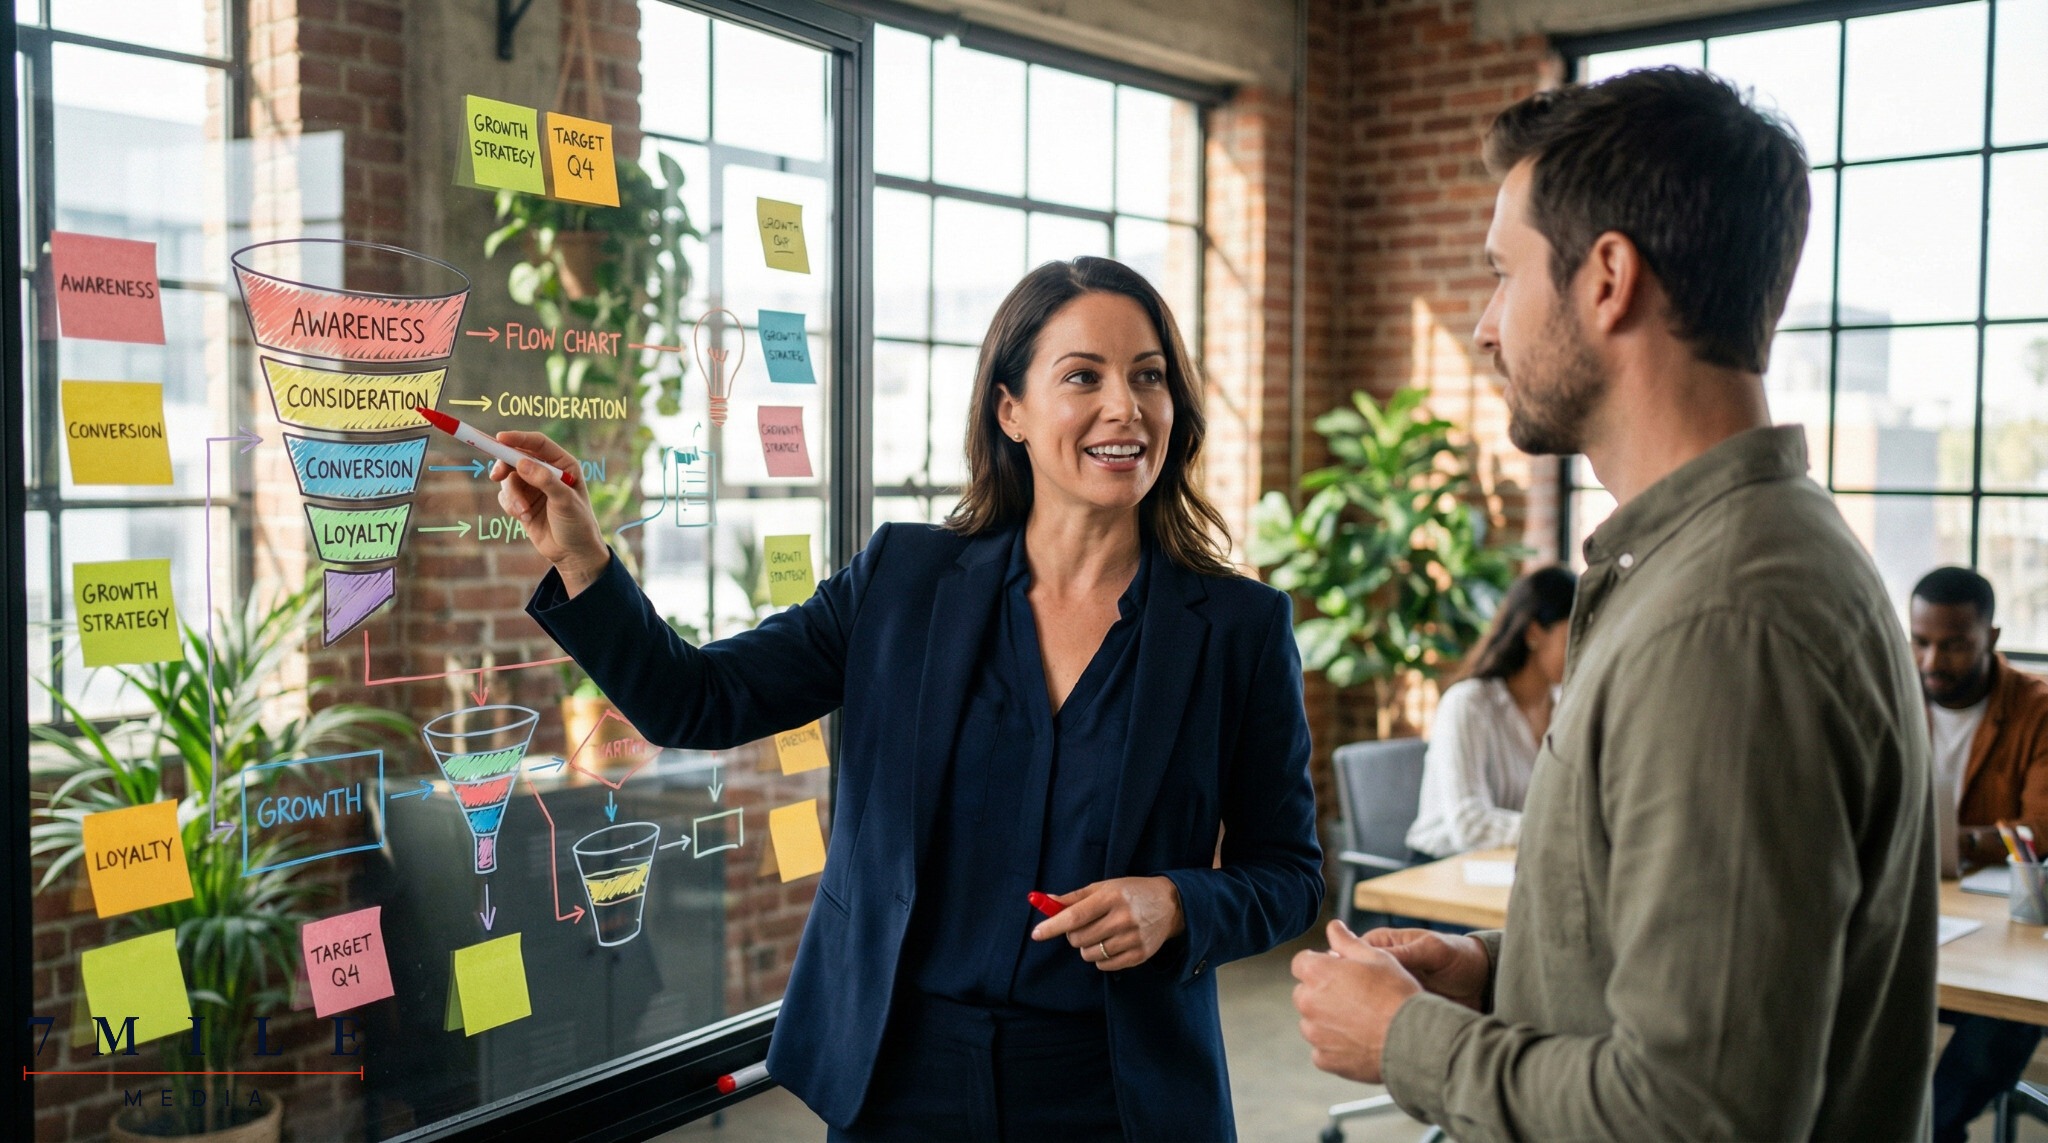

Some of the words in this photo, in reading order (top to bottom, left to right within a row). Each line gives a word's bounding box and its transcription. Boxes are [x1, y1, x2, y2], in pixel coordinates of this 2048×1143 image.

[474, 113, 529, 141] GROWTH
[552, 127, 605, 152] TARGET
[474, 140, 535, 168] STRATEGY
[567, 154, 595, 181] Q4
[60, 273, 155, 299] AWARENESS
[290, 307, 426, 345] AWARENESS
[505, 322, 556, 350] FLOW
[563, 329, 622, 357] CHART
[286, 383, 429, 411] CONSIDERATION
[497, 391, 628, 420] CONSIDERATION
[68, 421, 162, 440] CONVERSION
[305, 456, 414, 480] CONVERSION
[323, 521, 398, 547] LOYALTY
[478, 515, 529, 543] LOYA
[82, 580, 158, 604] GROWTH
[82, 607, 169, 632] STRATEGY
[257, 783, 362, 828] GROWTH
[95, 837, 173, 871] LOYALTY
[310, 933, 372, 965] TARGET
[331, 964, 360, 987] Q4
